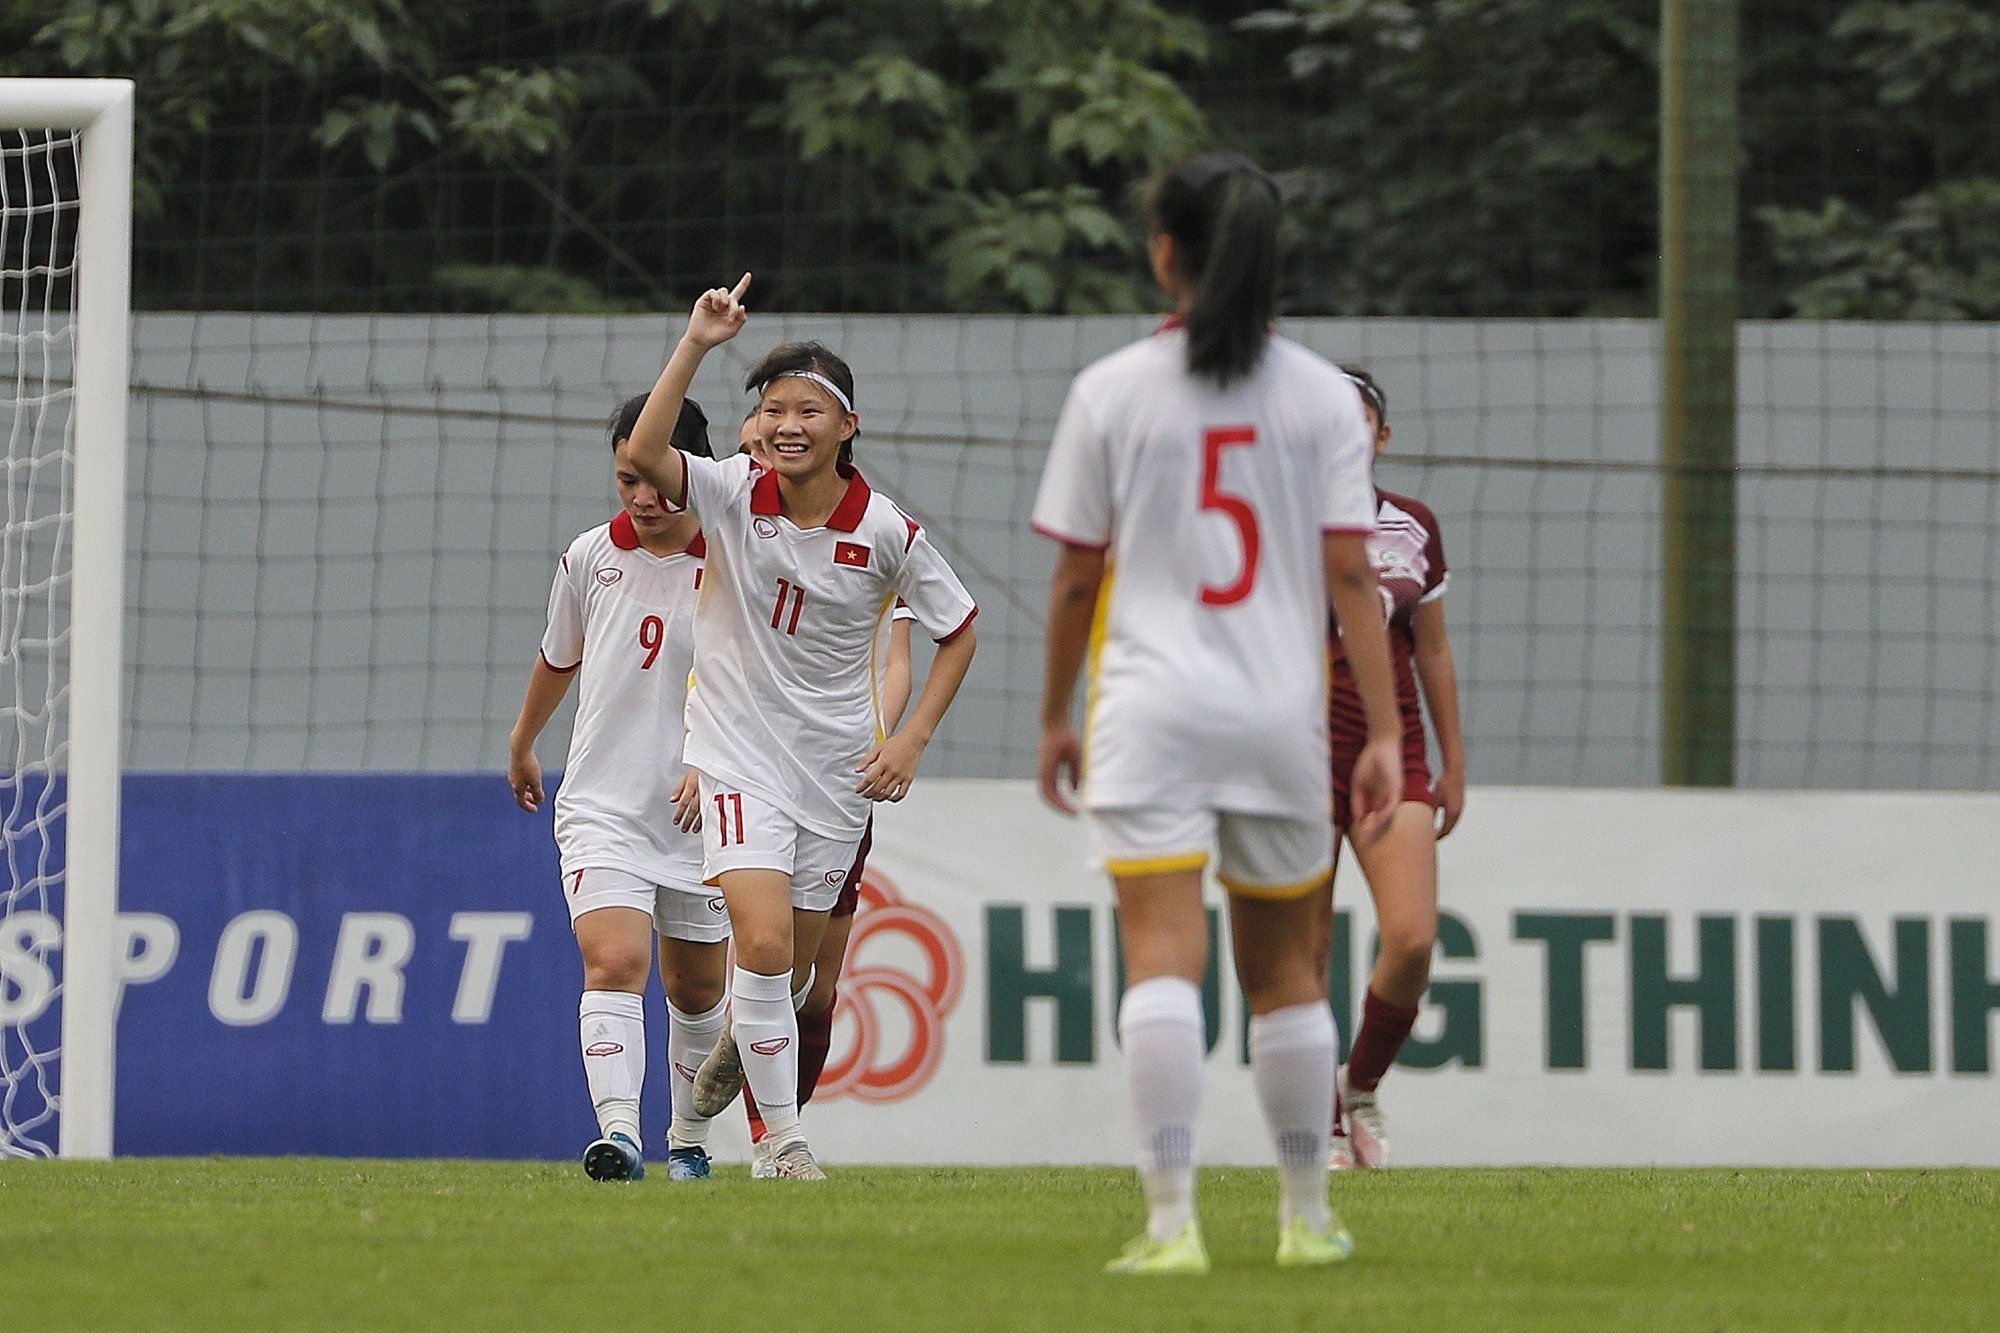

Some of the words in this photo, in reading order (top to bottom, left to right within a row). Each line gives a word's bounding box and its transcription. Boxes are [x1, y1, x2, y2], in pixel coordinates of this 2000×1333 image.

[1199, 425, 1261, 608] 5
[639, 614, 665, 670] 9
[771, 577, 805, 636] 11
[713, 792, 745, 848] 11
[0, 909, 534, 1027] SPORT
[984, 903, 1486, 1070] HG
